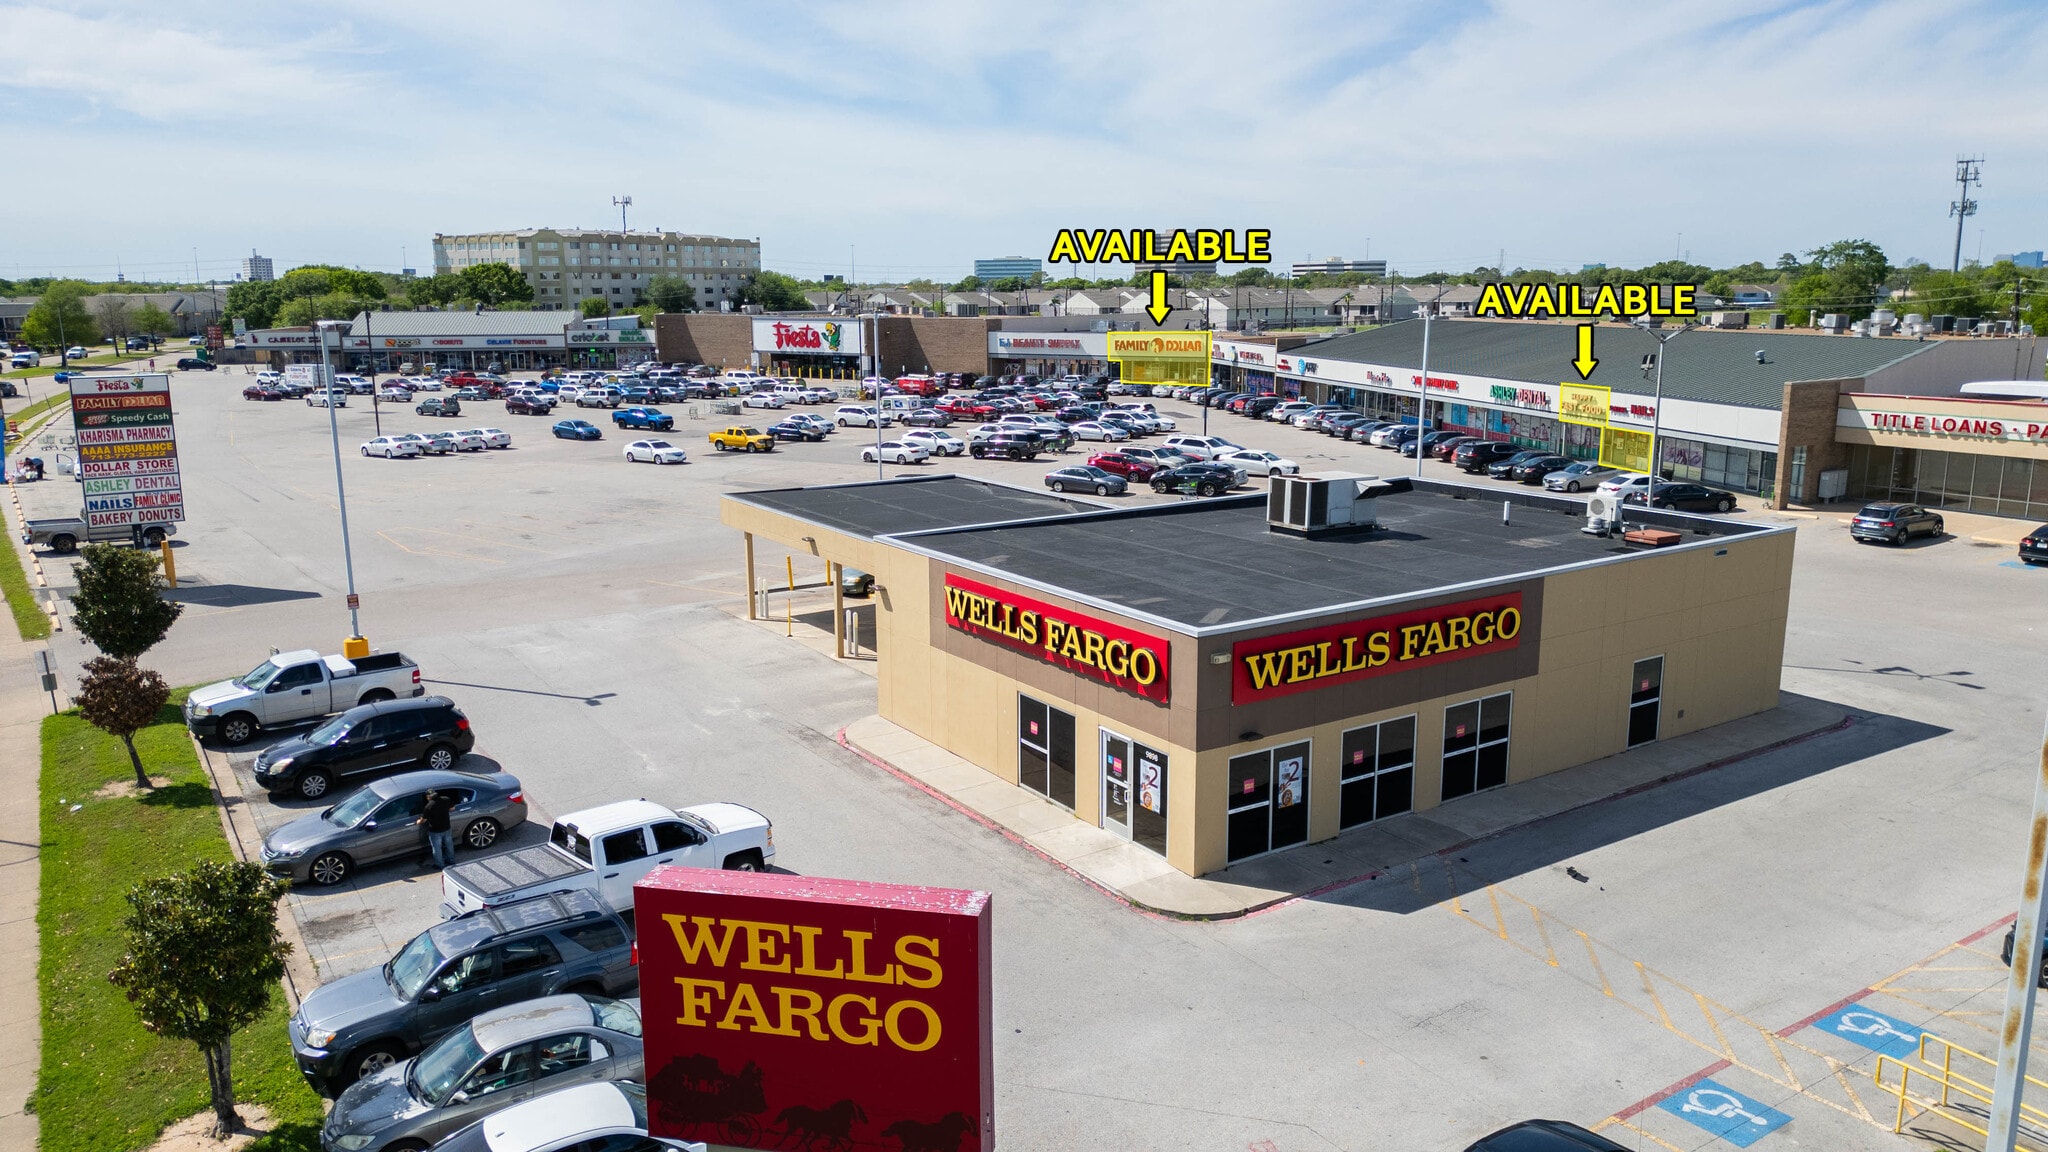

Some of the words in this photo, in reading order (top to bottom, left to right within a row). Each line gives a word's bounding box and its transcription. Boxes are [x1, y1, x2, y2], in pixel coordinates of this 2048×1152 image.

[772, 321, 822, 350] Fiesta
[1114, 339, 1149, 352] FAMILY
[1165, 340, 1202, 352] DOLLAR
[95, 379, 130, 392] Fiesta
[76, 397, 121, 410] FAMILY
[121, 395, 166, 408] DOLLAR
[1489, 385, 1516, 401] ASHLEY
[1518, 388, 1547, 406] DENTAL
[1581, 403, 1602, 415] FOOD
[111, 413, 145, 424] Speedy
[147, 411, 170, 421] Cash
[1871, 413, 1926, 430] TITLE
[1931, 417, 2003, 436] LOANS
[79, 429, 124, 444] KHARISMA
[127, 426, 171, 441] PHARMACY
[82, 446, 111, 456] AAAA
[113, 442, 173, 454] INSURANCE
[90, 451, 167, 460] 713-773-2222
[84, 462, 130, 473] DOLLAR
[136, 458, 175, 469] STORE
[86, 478, 130, 493] ASHLEY
[135, 476, 179, 490] DENTAL
[89, 497, 133, 511] NAILS
[135, 494, 158, 507] FAMILY
[91, 511, 133, 526] BAKERY
[138, 508, 181, 521] DONUTS
[944, 585, 1040, 645] WELLS
[1044, 616, 1157, 686] FARGO
[1245, 630, 1391, 690] WELLS
[1400, 606, 1522, 662] FARGO
[661, 913, 943, 989] WELLS
[673, 976, 943, 1052] FARGO
